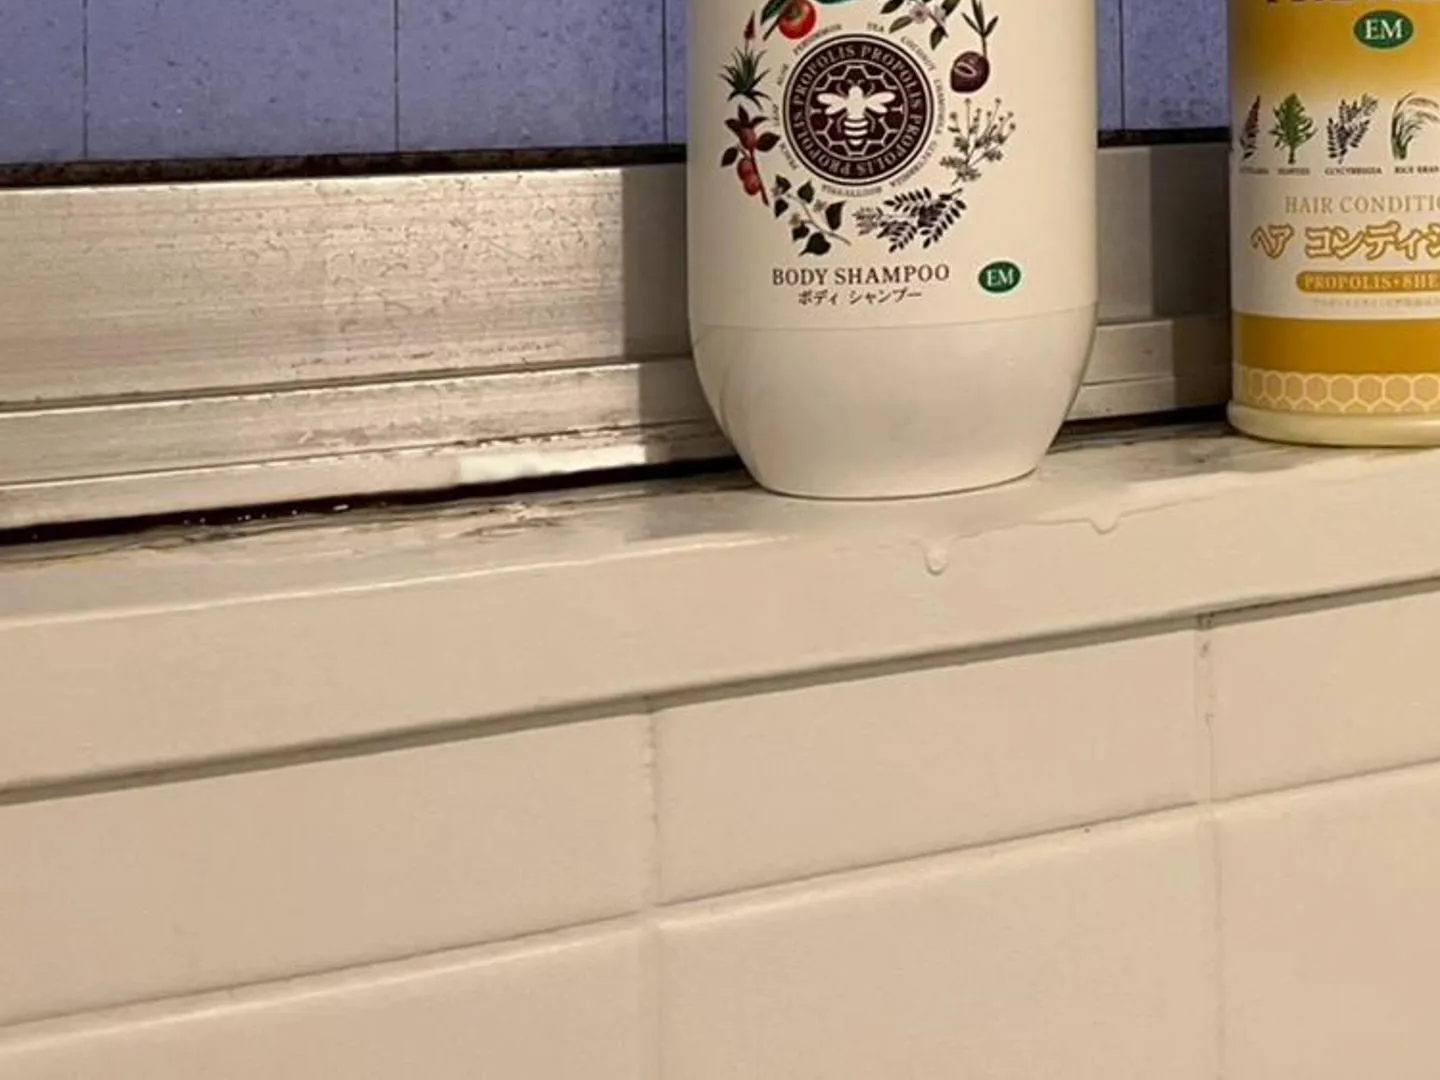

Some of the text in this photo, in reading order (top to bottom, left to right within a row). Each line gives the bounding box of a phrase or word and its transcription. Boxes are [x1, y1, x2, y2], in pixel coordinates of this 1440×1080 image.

[1365, 19, 1401, 40] EM
[1285, 195, 1333, 214] HAIR
[1251, 222, 1294, 260] ヘア
[773, 265, 949, 285] BODY SHAMPOO
[987, 270, 1013, 286] EM
